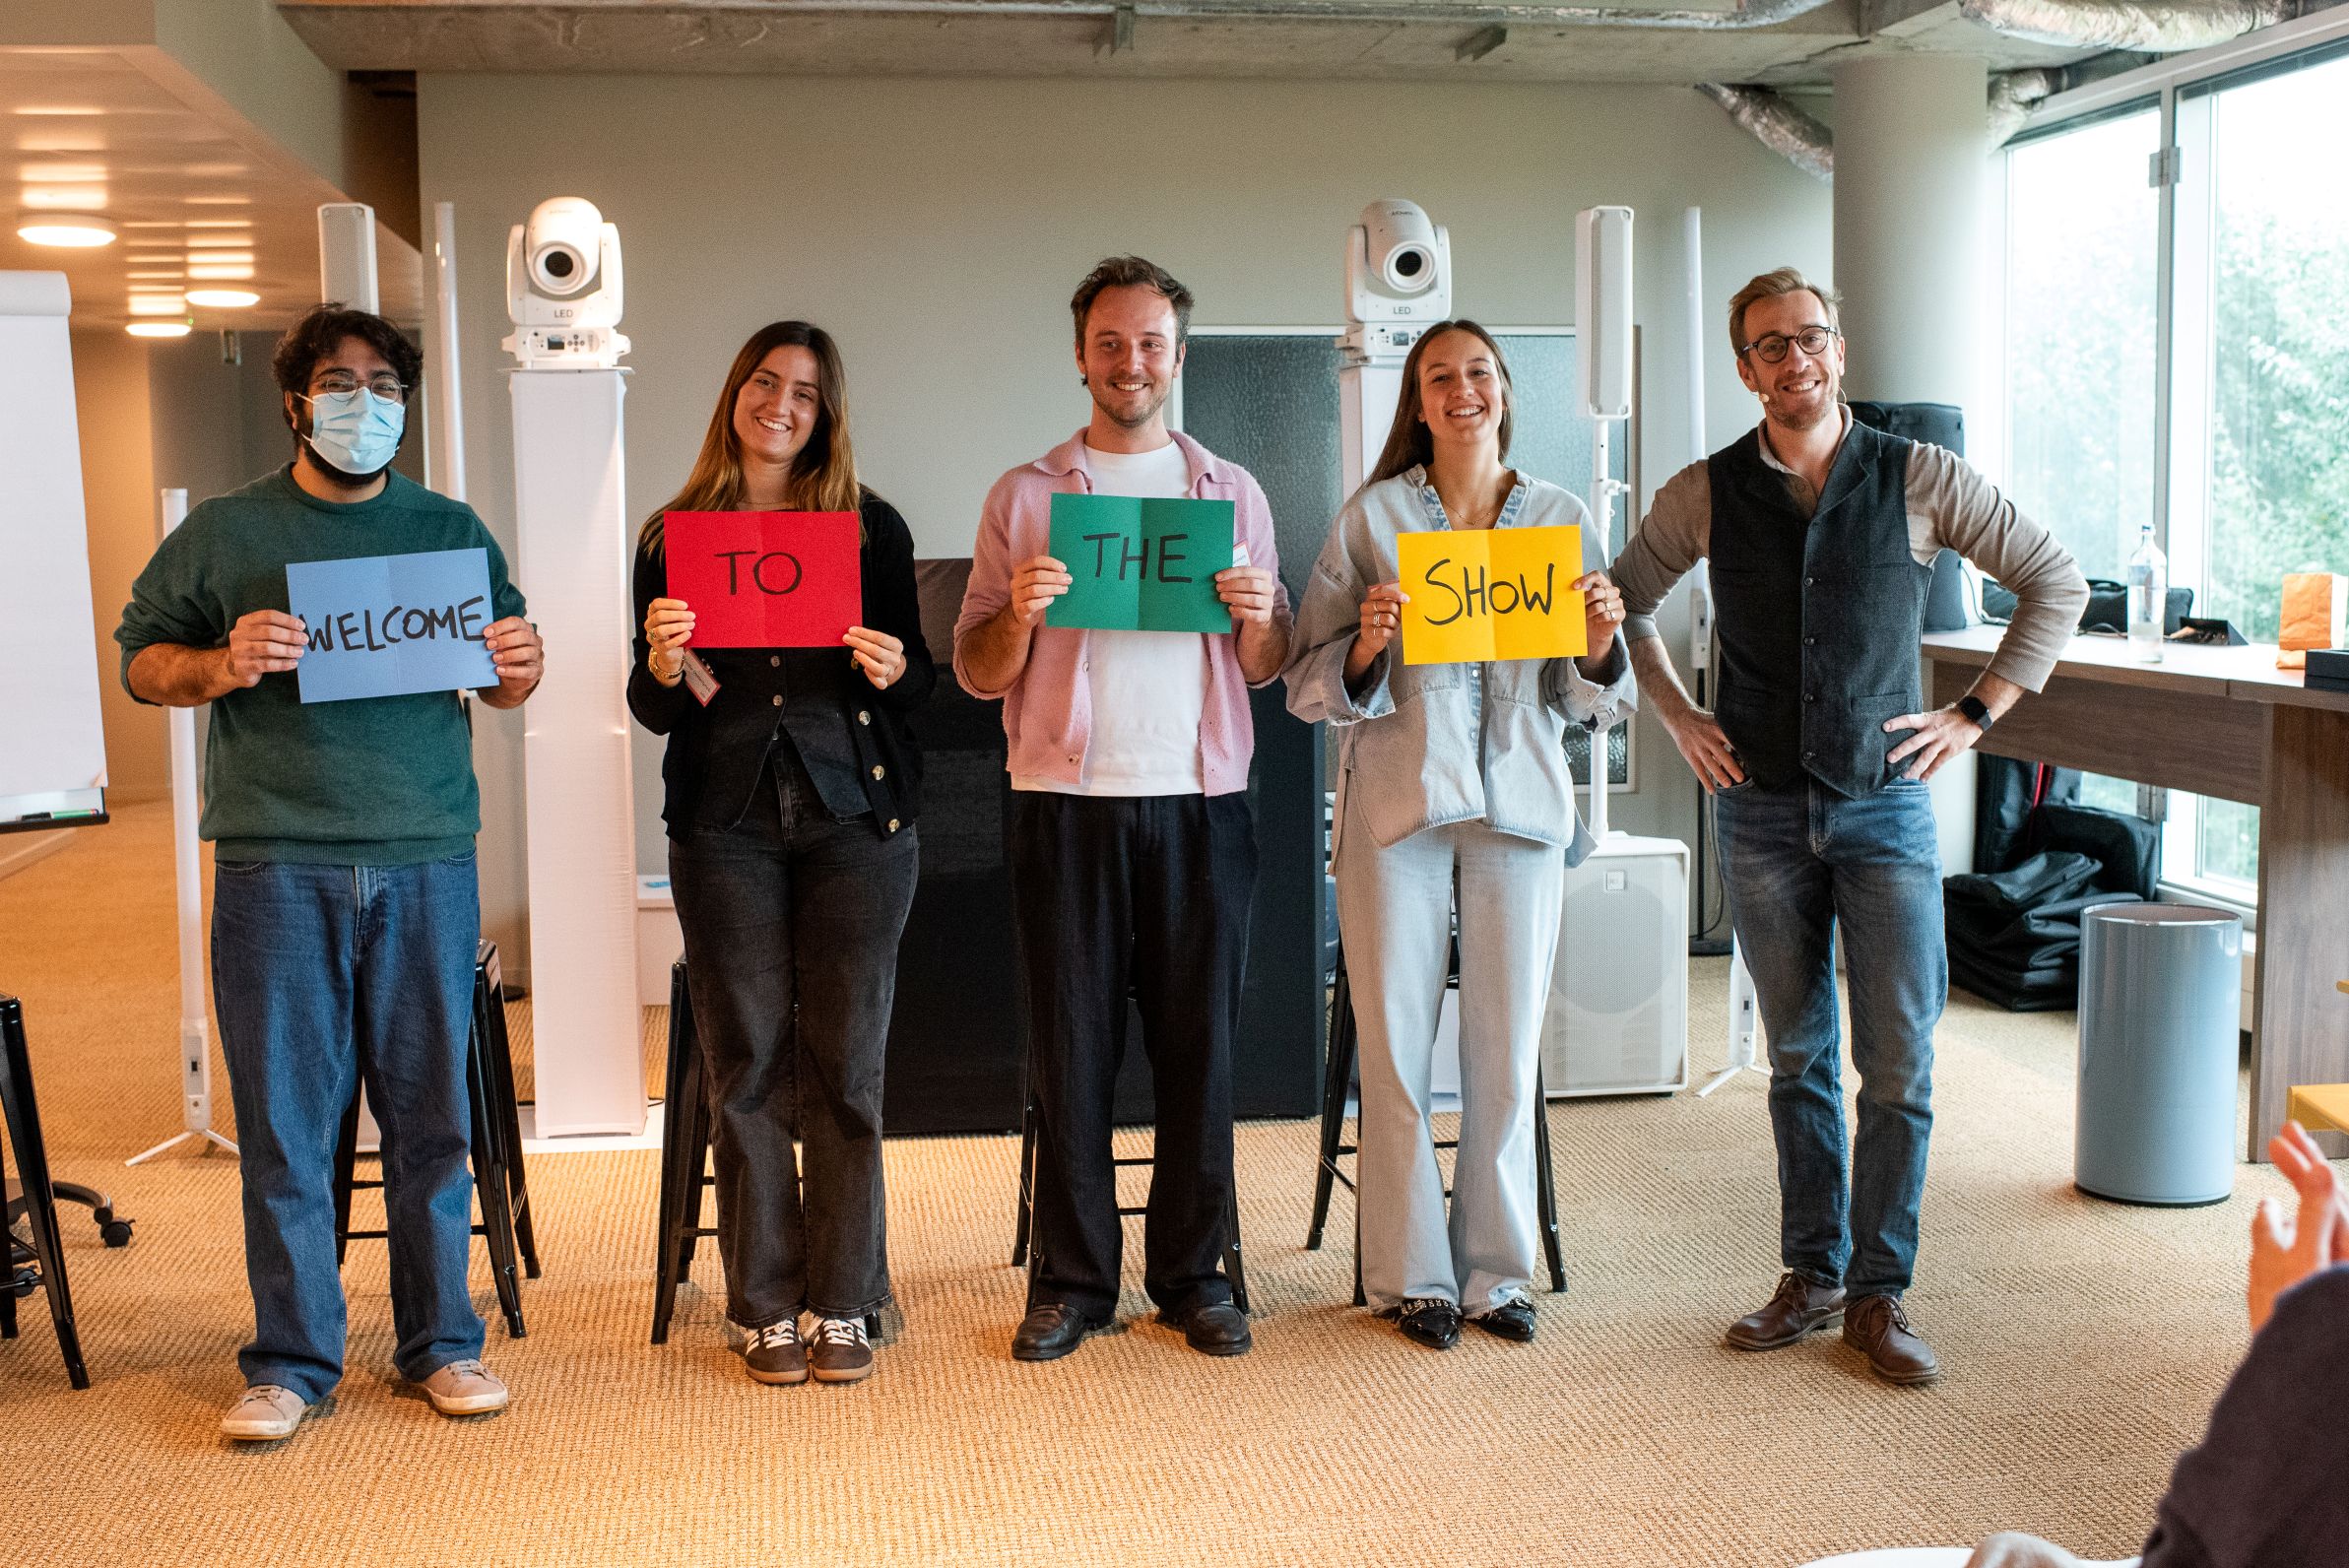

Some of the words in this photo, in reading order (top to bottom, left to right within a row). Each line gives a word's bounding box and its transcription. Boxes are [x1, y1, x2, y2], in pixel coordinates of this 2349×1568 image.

[555, 309, 573, 318] LED
[1393, 306, 1411, 315] LED
[713, 551, 803, 595] TO
[1082, 533, 1193, 583] THE
[1424, 558, 1555, 625] SHOW
[298, 595, 486, 652] WELCOME
